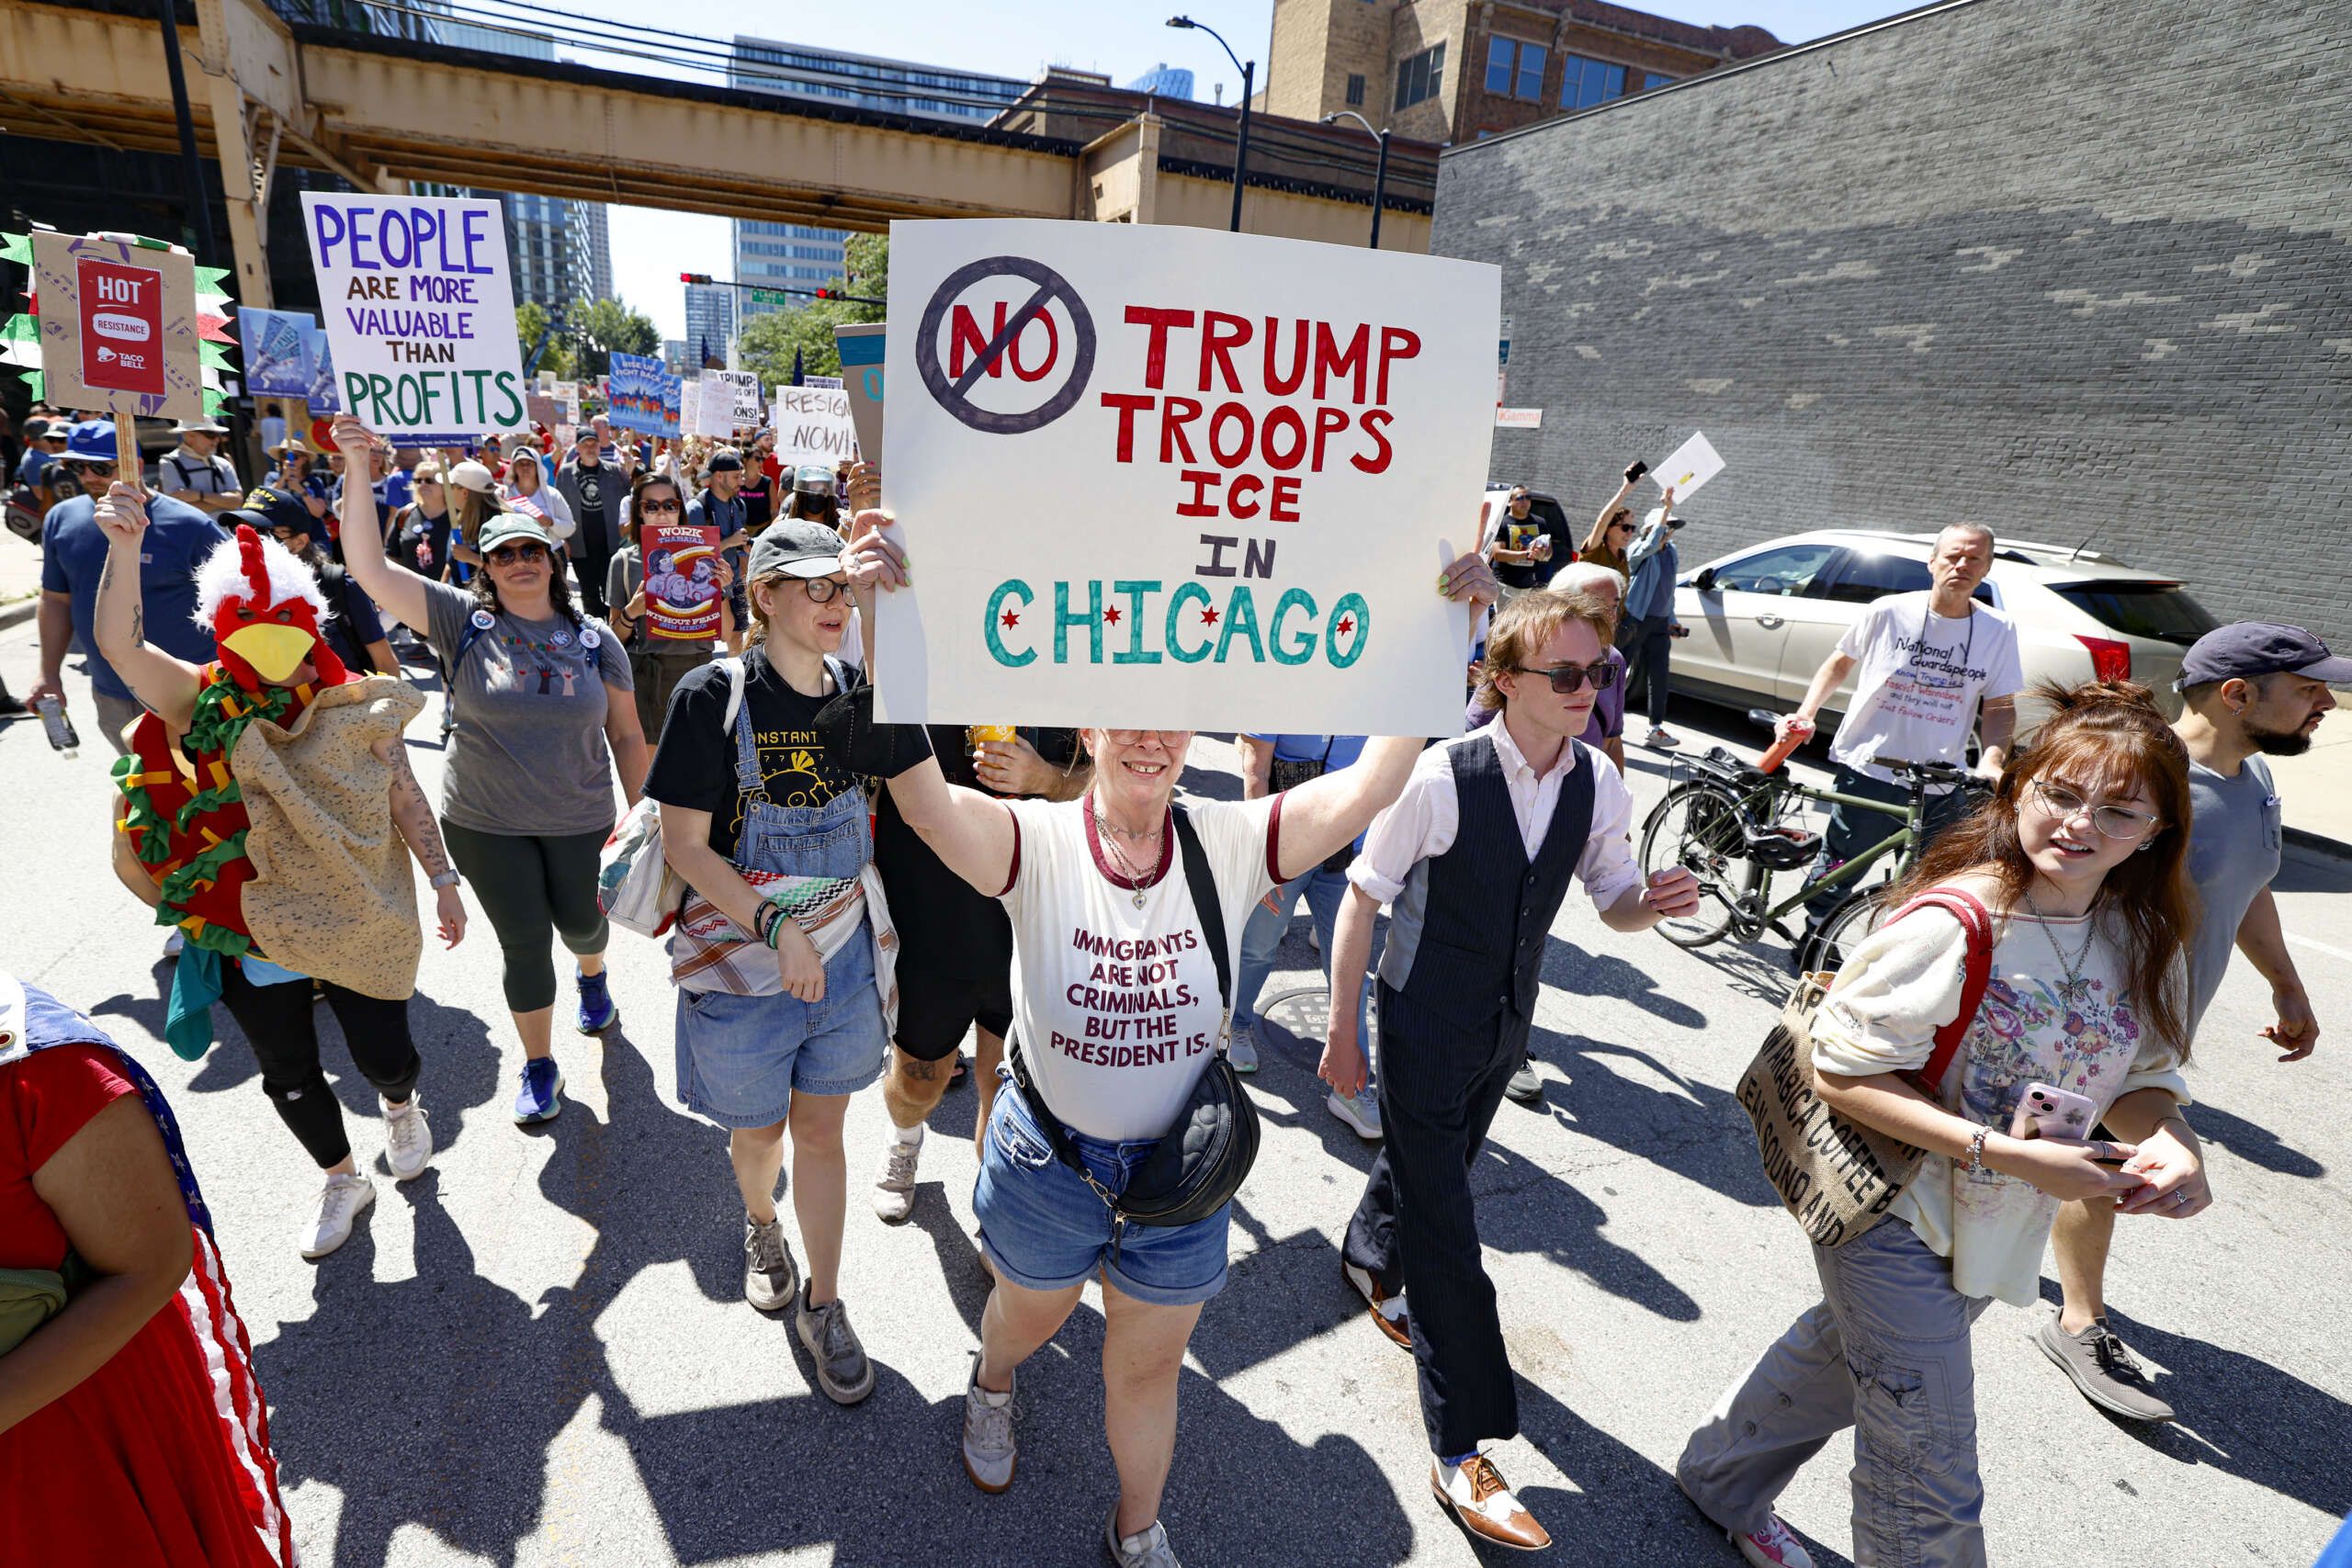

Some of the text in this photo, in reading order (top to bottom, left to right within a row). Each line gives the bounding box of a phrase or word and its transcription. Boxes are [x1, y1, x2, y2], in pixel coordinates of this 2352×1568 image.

[314, 204, 493, 274] PEOPLE
[97, 276, 141, 304] HOT
[347, 276, 479, 303] ARE MORE
[97, 320, 146, 335] RESISTANCE
[346, 307, 474, 339] VALUABLE
[386, 341, 455, 363] THAN
[949, 301, 1058, 382] NO
[1124, 305, 1421, 405] TRUMP
[119, 353, 144, 362] TACO
[120, 361, 146, 369] BELL
[345, 369, 523, 426] PROFITS
[786, 391, 851, 419] RESIGN
[794, 424, 850, 457] NOW!
[1100, 391, 1395, 474] TROOPS
[1176, 469, 1302, 523] ICE
[658, 526, 704, 537] WORK
[1195, 534, 1276, 579] IN
[646, 610, 691, 626] WITHOUT
[984, 579, 1368, 669] CHICAGO
[1895, 637, 1954, 660] National
[1910, 655, 1987, 682] Guardspeople
[1090, 959, 1179, 987] ARE NOT
[1067, 984, 1199, 1015] CRIMINALS,
[1085, 1014, 1177, 1041] BUT THE
[1050, 1031, 1210, 1067] PRESIDENT IS.
[1764, 1032, 1823, 1137] ARABICA
[1806, 1113, 1886, 1206] COFFEE
[1762, 1122, 1811, 1204] SOUND
[1800, 1190, 1846, 1247] AND
